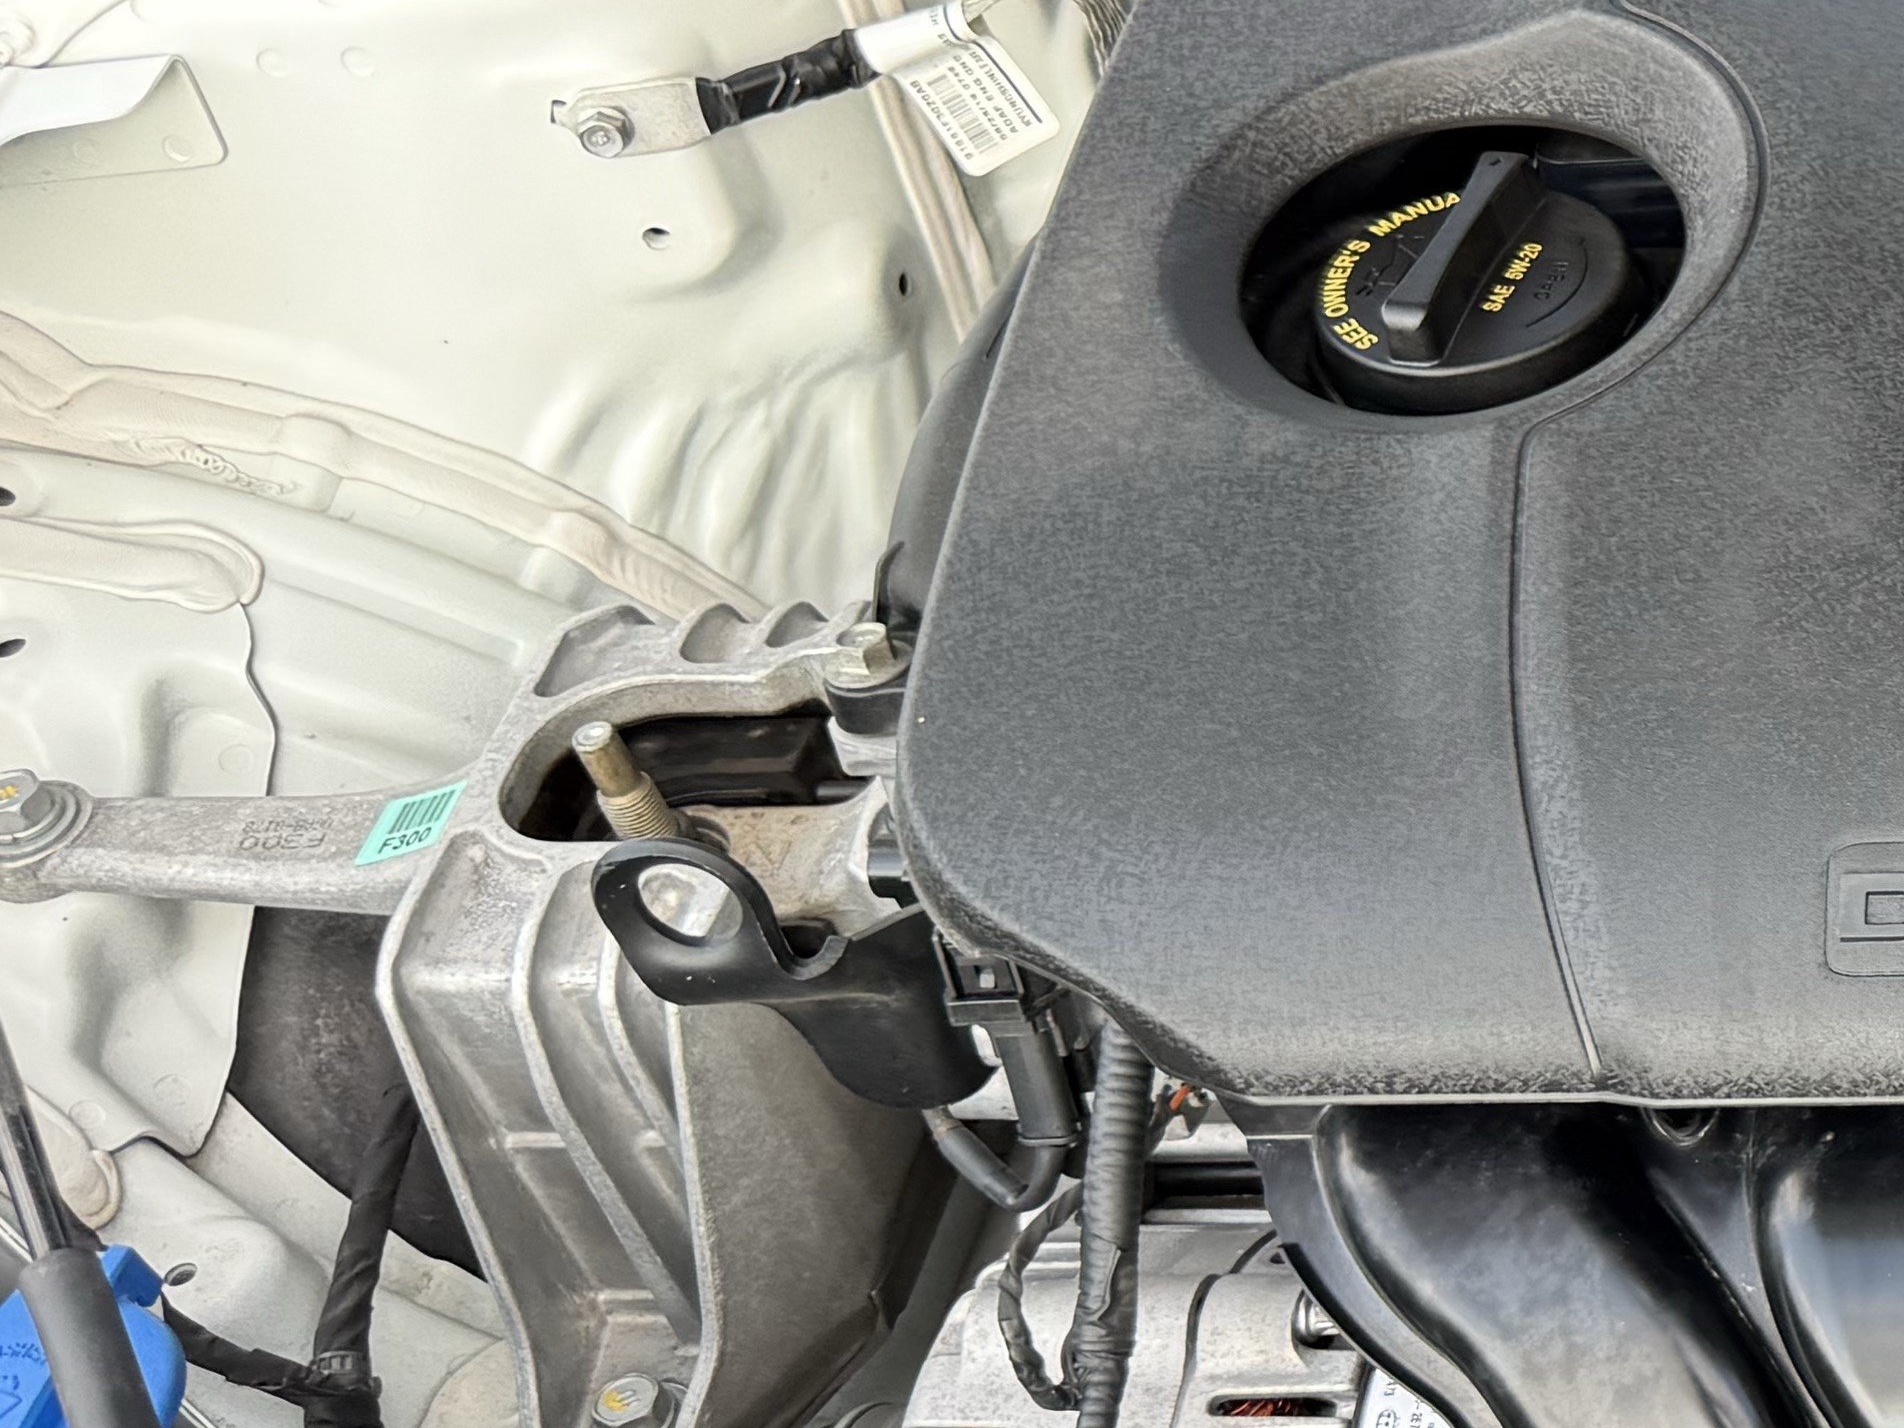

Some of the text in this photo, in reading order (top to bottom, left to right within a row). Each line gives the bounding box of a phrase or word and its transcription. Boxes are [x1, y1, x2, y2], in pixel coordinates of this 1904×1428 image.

[1322, 192, 1462, 350] SEE OWNER'S MANUA
[1482, 242, 1544, 313] SAE 5W-20
[377, 826, 432, 855] F300
